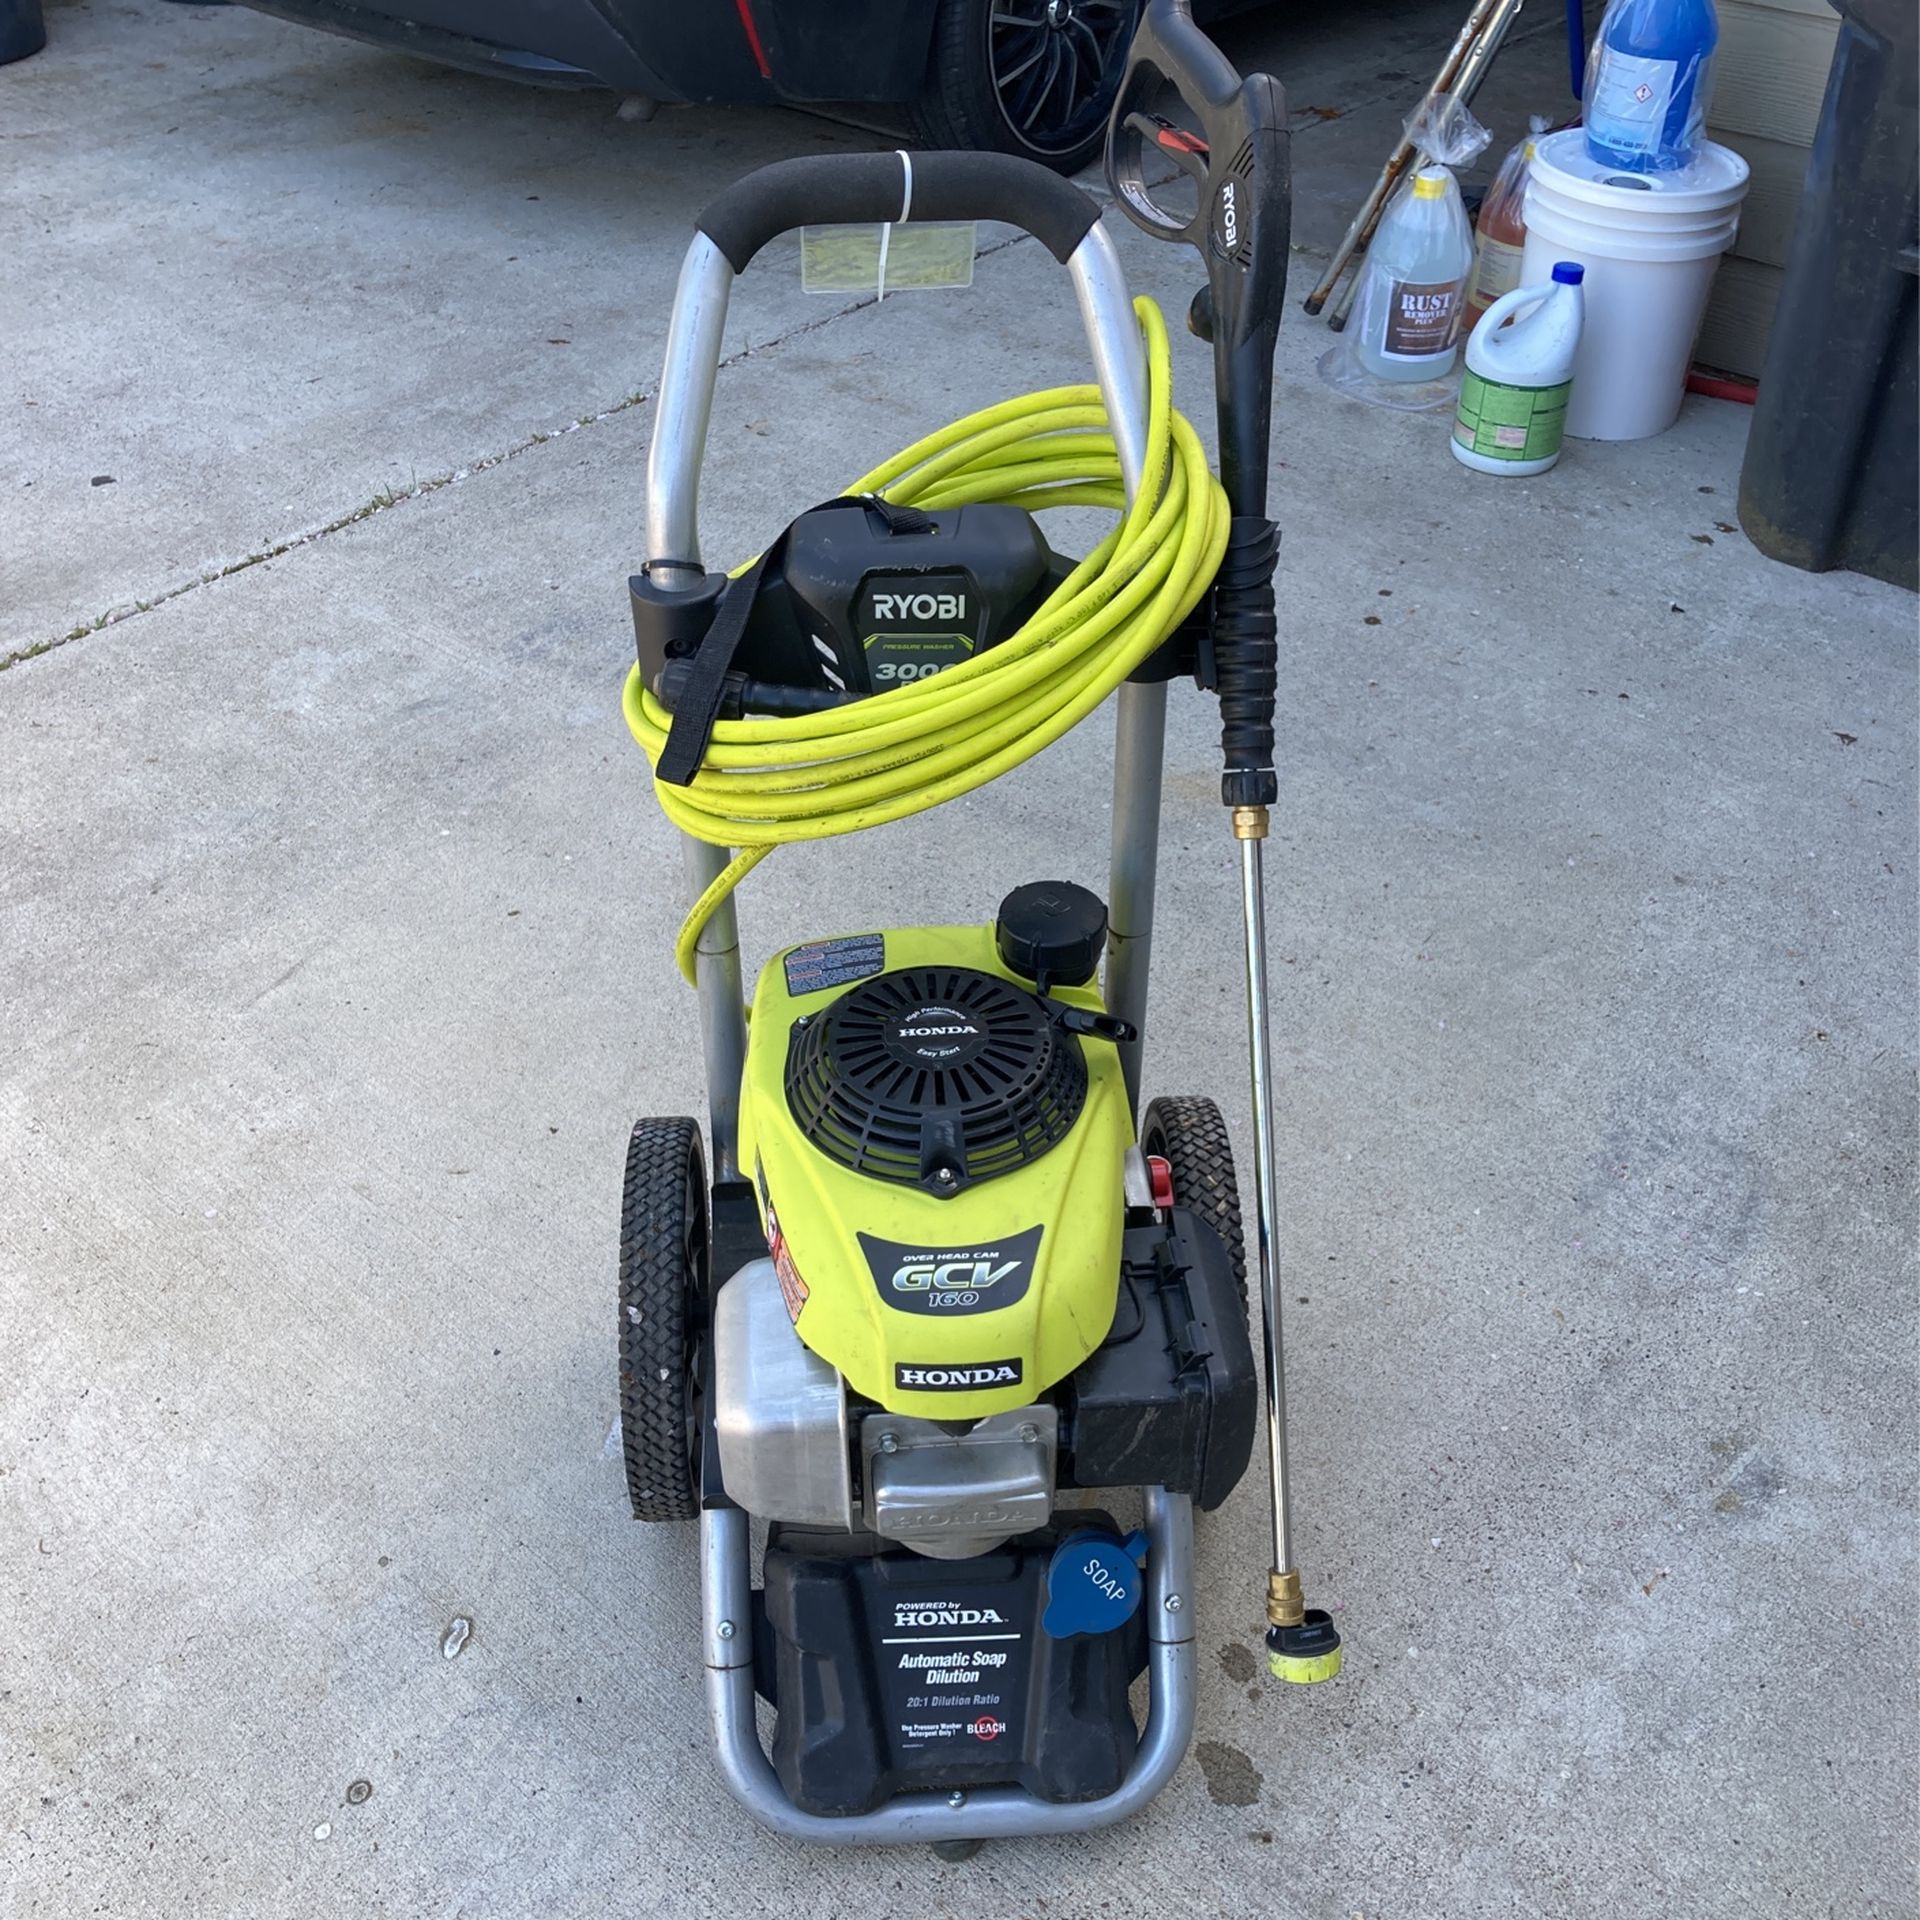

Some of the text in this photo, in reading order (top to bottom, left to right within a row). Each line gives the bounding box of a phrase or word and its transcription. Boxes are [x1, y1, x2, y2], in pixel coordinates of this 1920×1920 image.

[1223, 182, 1237, 247] RYOBI
[1401, 292, 1453, 311] RUST
[873, 594, 965, 619] RYOBI
[905, 1006, 966, 1022] High Performance
[899, 1025, 979, 1037] HONDA
[917, 1046, 960, 1058] Easy Start
[903, 1251, 1000, 1262] OVER HEAD CAM
[892, 1261, 1023, 1292] GCV
[929, 1291, 979, 1307] 160
[901, 1366, 1018, 1385] HONDA
[1083, 1559, 1126, 1600] SOAP
[896, 1602, 961, 1610] POWERED by
[894, 1609, 1003, 1627] HONDA
[898, 1651, 1007, 1669] Automatic Soap
[926, 1669, 980, 1685] Dilution
[906, 1694, 1000, 1708] 20:1 Dilution Ratio
[967, 1723, 1006, 1735] BLEACH
